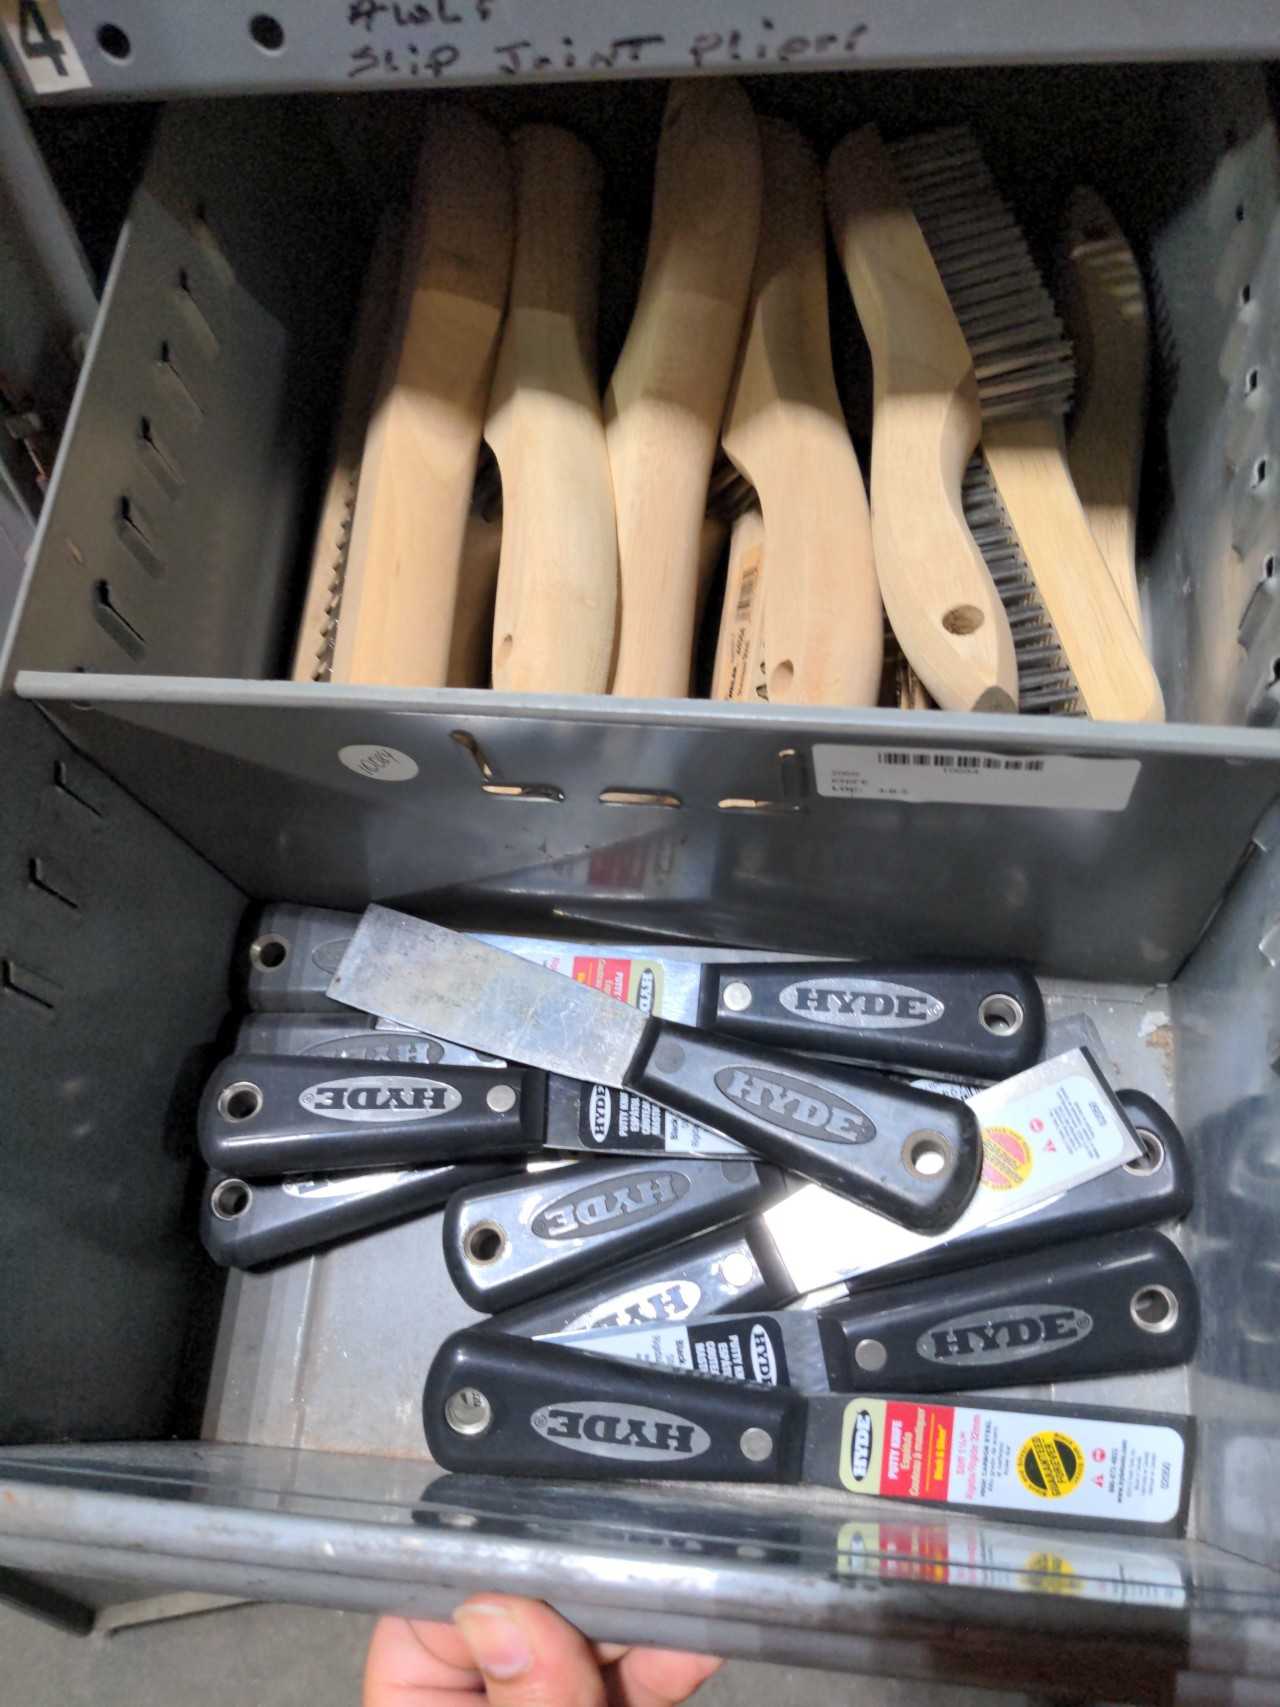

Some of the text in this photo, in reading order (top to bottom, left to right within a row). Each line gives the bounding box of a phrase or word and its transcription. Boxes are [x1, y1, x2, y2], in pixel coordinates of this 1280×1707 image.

[18, 0, 69, 77] 4
[794, 987, 929, 1021] HYDE
[313, 1086, 448, 1110] HYDE
[727, 1070, 864, 1142] HYDE
[544, 1174, 679, 1237] HYDE
[930, 1311, 1079, 1359] HYDE
[547, 1409, 695, 1453] HYDE
[853, 1413, 871, 1478] HYDE
